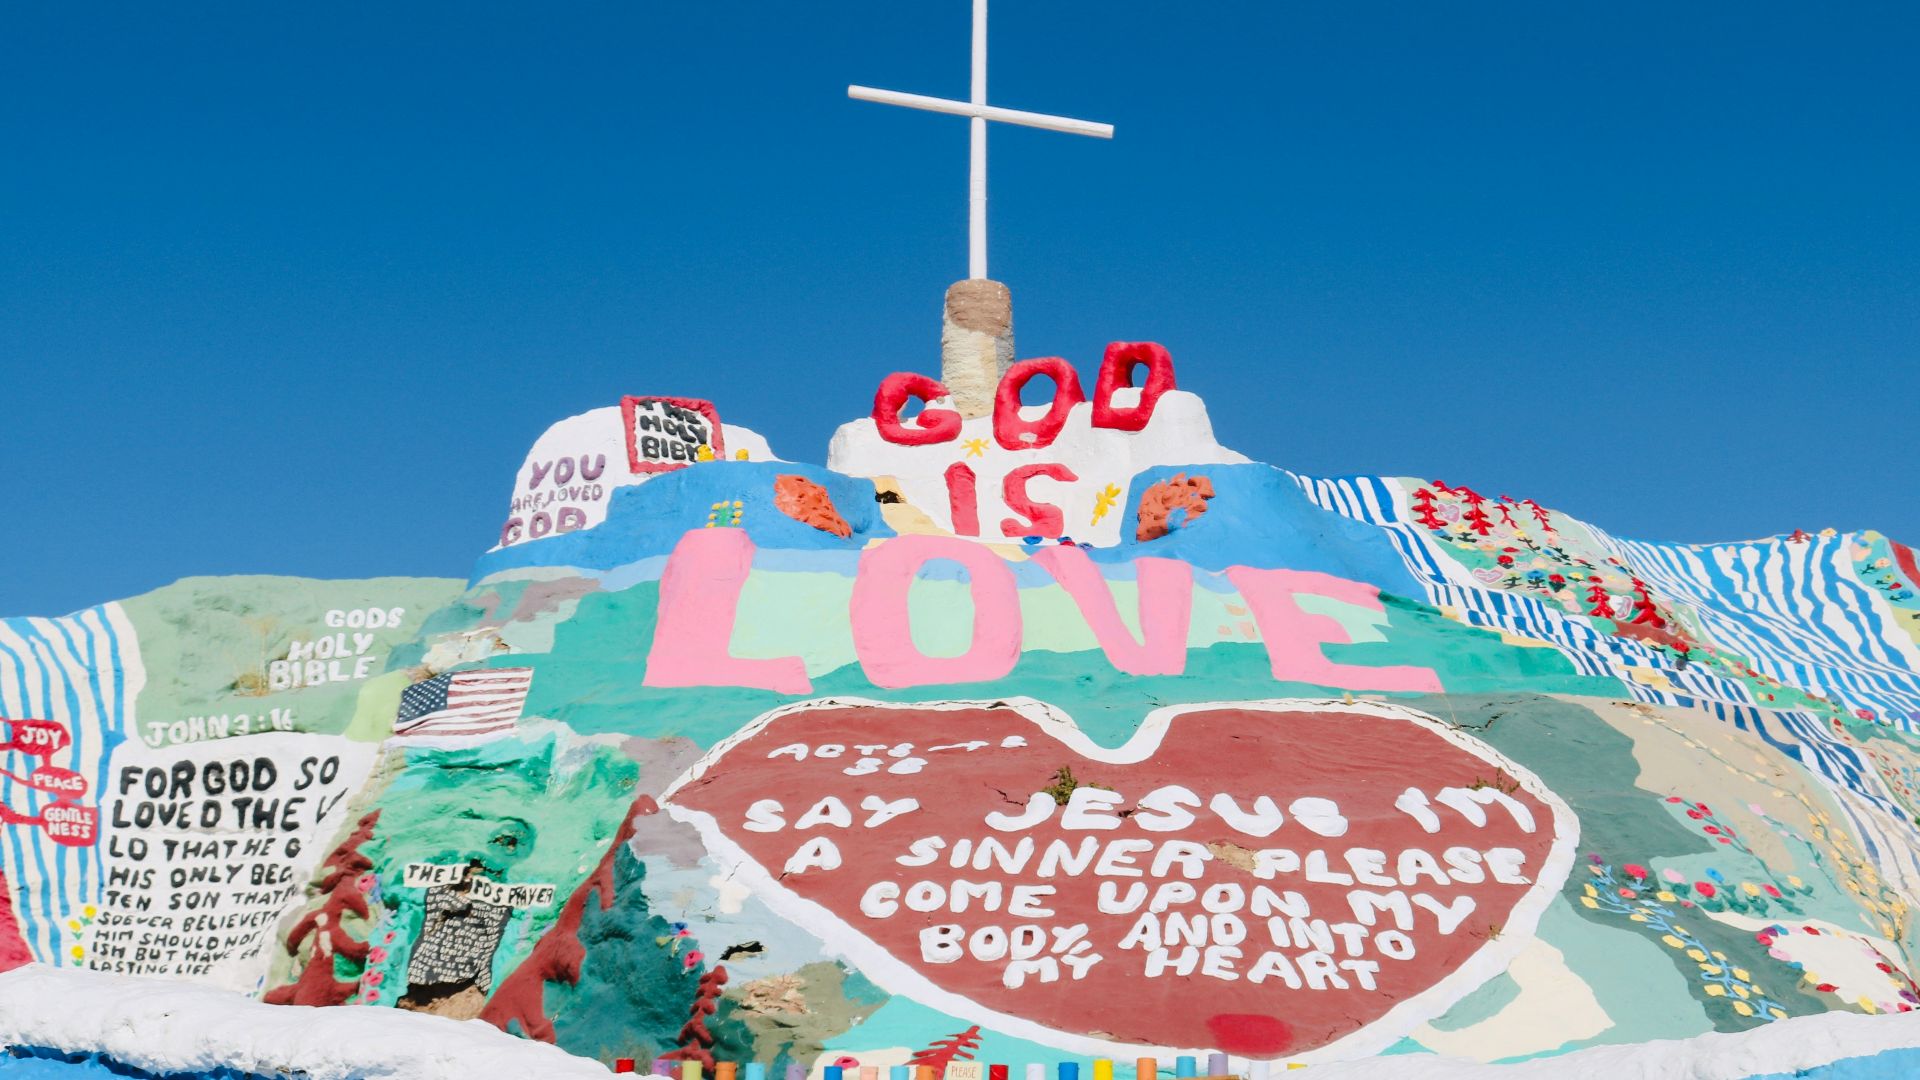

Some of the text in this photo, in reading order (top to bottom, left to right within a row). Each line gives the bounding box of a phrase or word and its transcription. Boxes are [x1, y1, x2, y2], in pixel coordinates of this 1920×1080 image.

[872, 341, 1177, 450] GOD
[640, 415, 707, 444] HOLY
[529, 454, 606, 490] YOU
[510, 484, 603, 513] ARE LOVED
[944, 461, 1079, 538] IS
[501, 507, 587, 547] GOD
[325, 607, 404, 629] GODS
[642, 528, 1444, 694] LOVE
[287, 632, 374, 662] HOLY
[269, 656, 375, 690] BIBLE
[20, 725, 62, 750] JOY
[144, 714, 229, 748] JOHN
[768, 743, 915, 762] ACTS
[31, 773, 84, 791] PEACE
[120, 756, 339, 800] FOR GOD SO
[44, 807, 94, 825] GENTLE
[112, 799, 221, 829] LOVED
[232, 797, 306, 832] THE
[743, 795, 920, 833] SAY
[984, 785, 1349, 838] JESUS
[48, 822, 91, 839] NESS
[163, 838, 238, 862] THAT
[242, 838, 276, 857] HE
[784, 835, 1528, 887] A SINNER PLEASE
[109, 865, 155, 889] HIS
[170, 863, 243, 888] ONLY
[408, 864, 446, 883] THE
[106, 891, 152, 911] TEN
[168, 891, 220, 910] SON
[860, 880, 1477, 936] COME UPON MY
[96, 929, 133, 942] HIM
[139, 932, 219, 951] SHOULD
[1118, 911, 1247, 952] AND
[1266, 915, 1416, 961] INTO
[90, 960, 215, 975] LASTING LIFE
[135, 947, 178, 962] BUT
[1002, 946, 1381, 990] MY HEART
[951, 1065, 977, 1079] PLEASE
